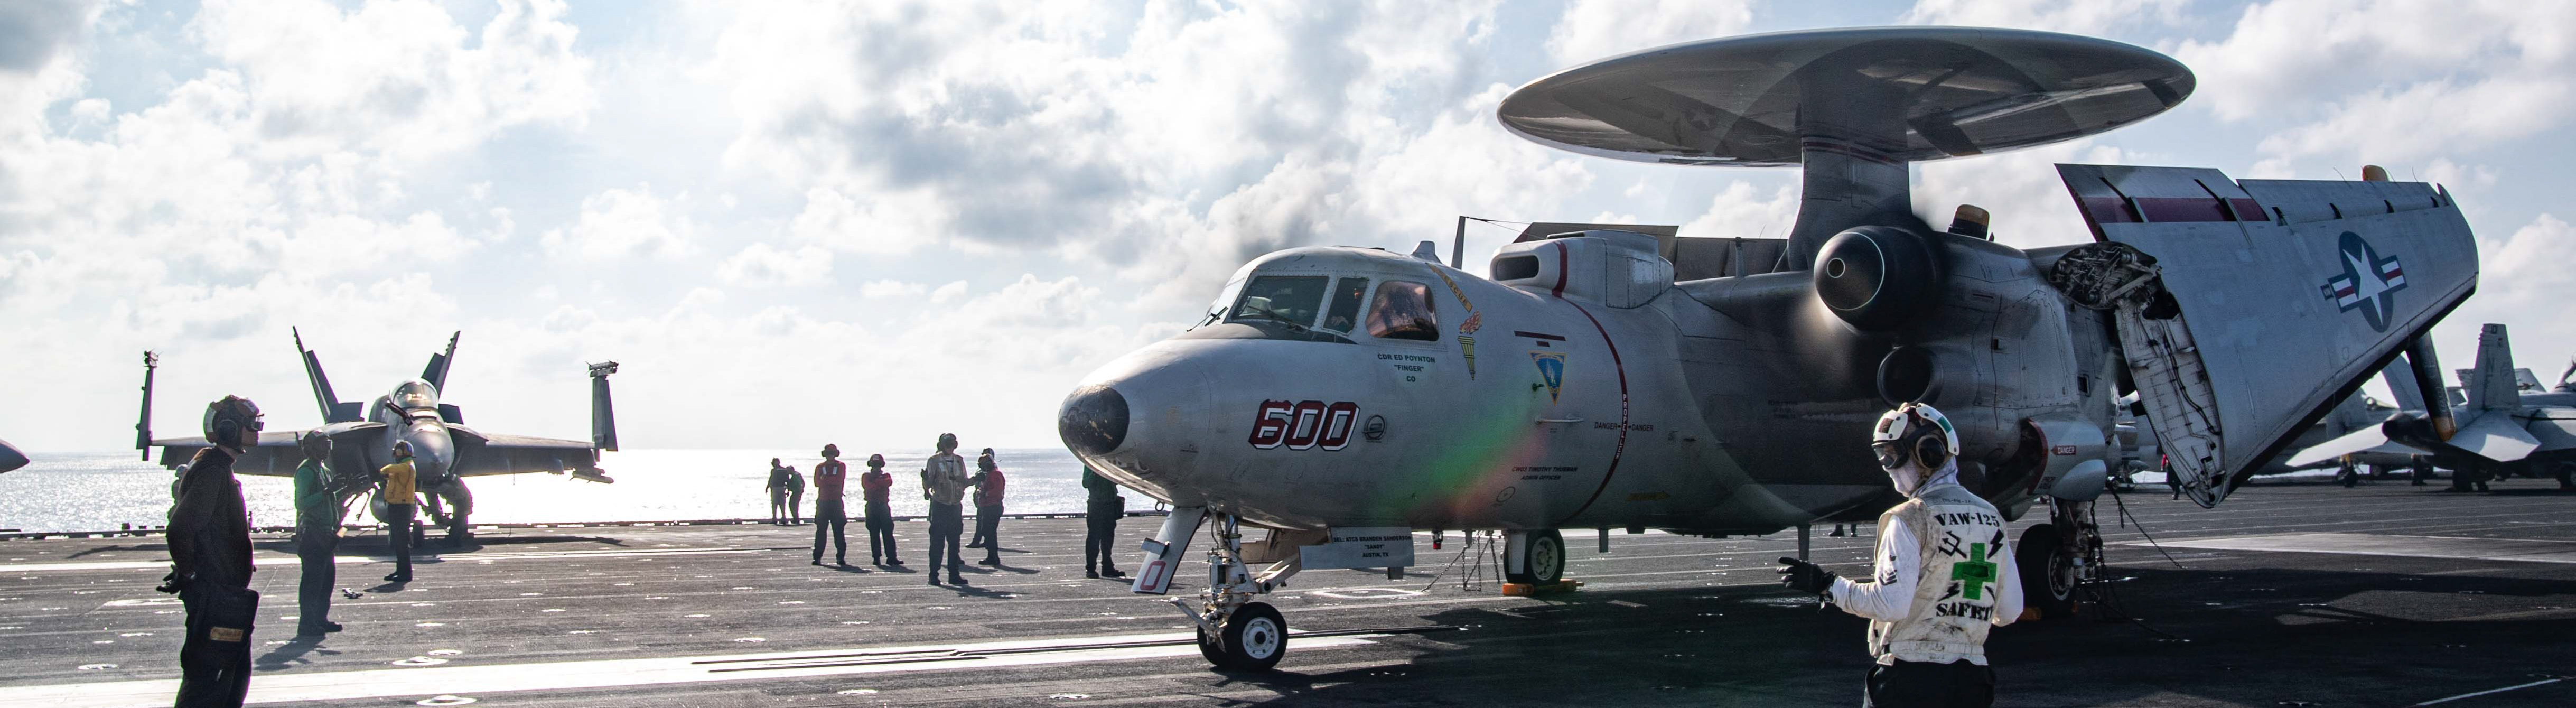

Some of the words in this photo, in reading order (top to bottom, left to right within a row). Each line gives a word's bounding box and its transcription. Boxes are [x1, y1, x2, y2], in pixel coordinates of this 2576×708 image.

[1248, 398, 1361, 452] 600
[1616, 394, 1627, 459] PROPELLER
[1934, 512, 2000, 527] VAW-125
